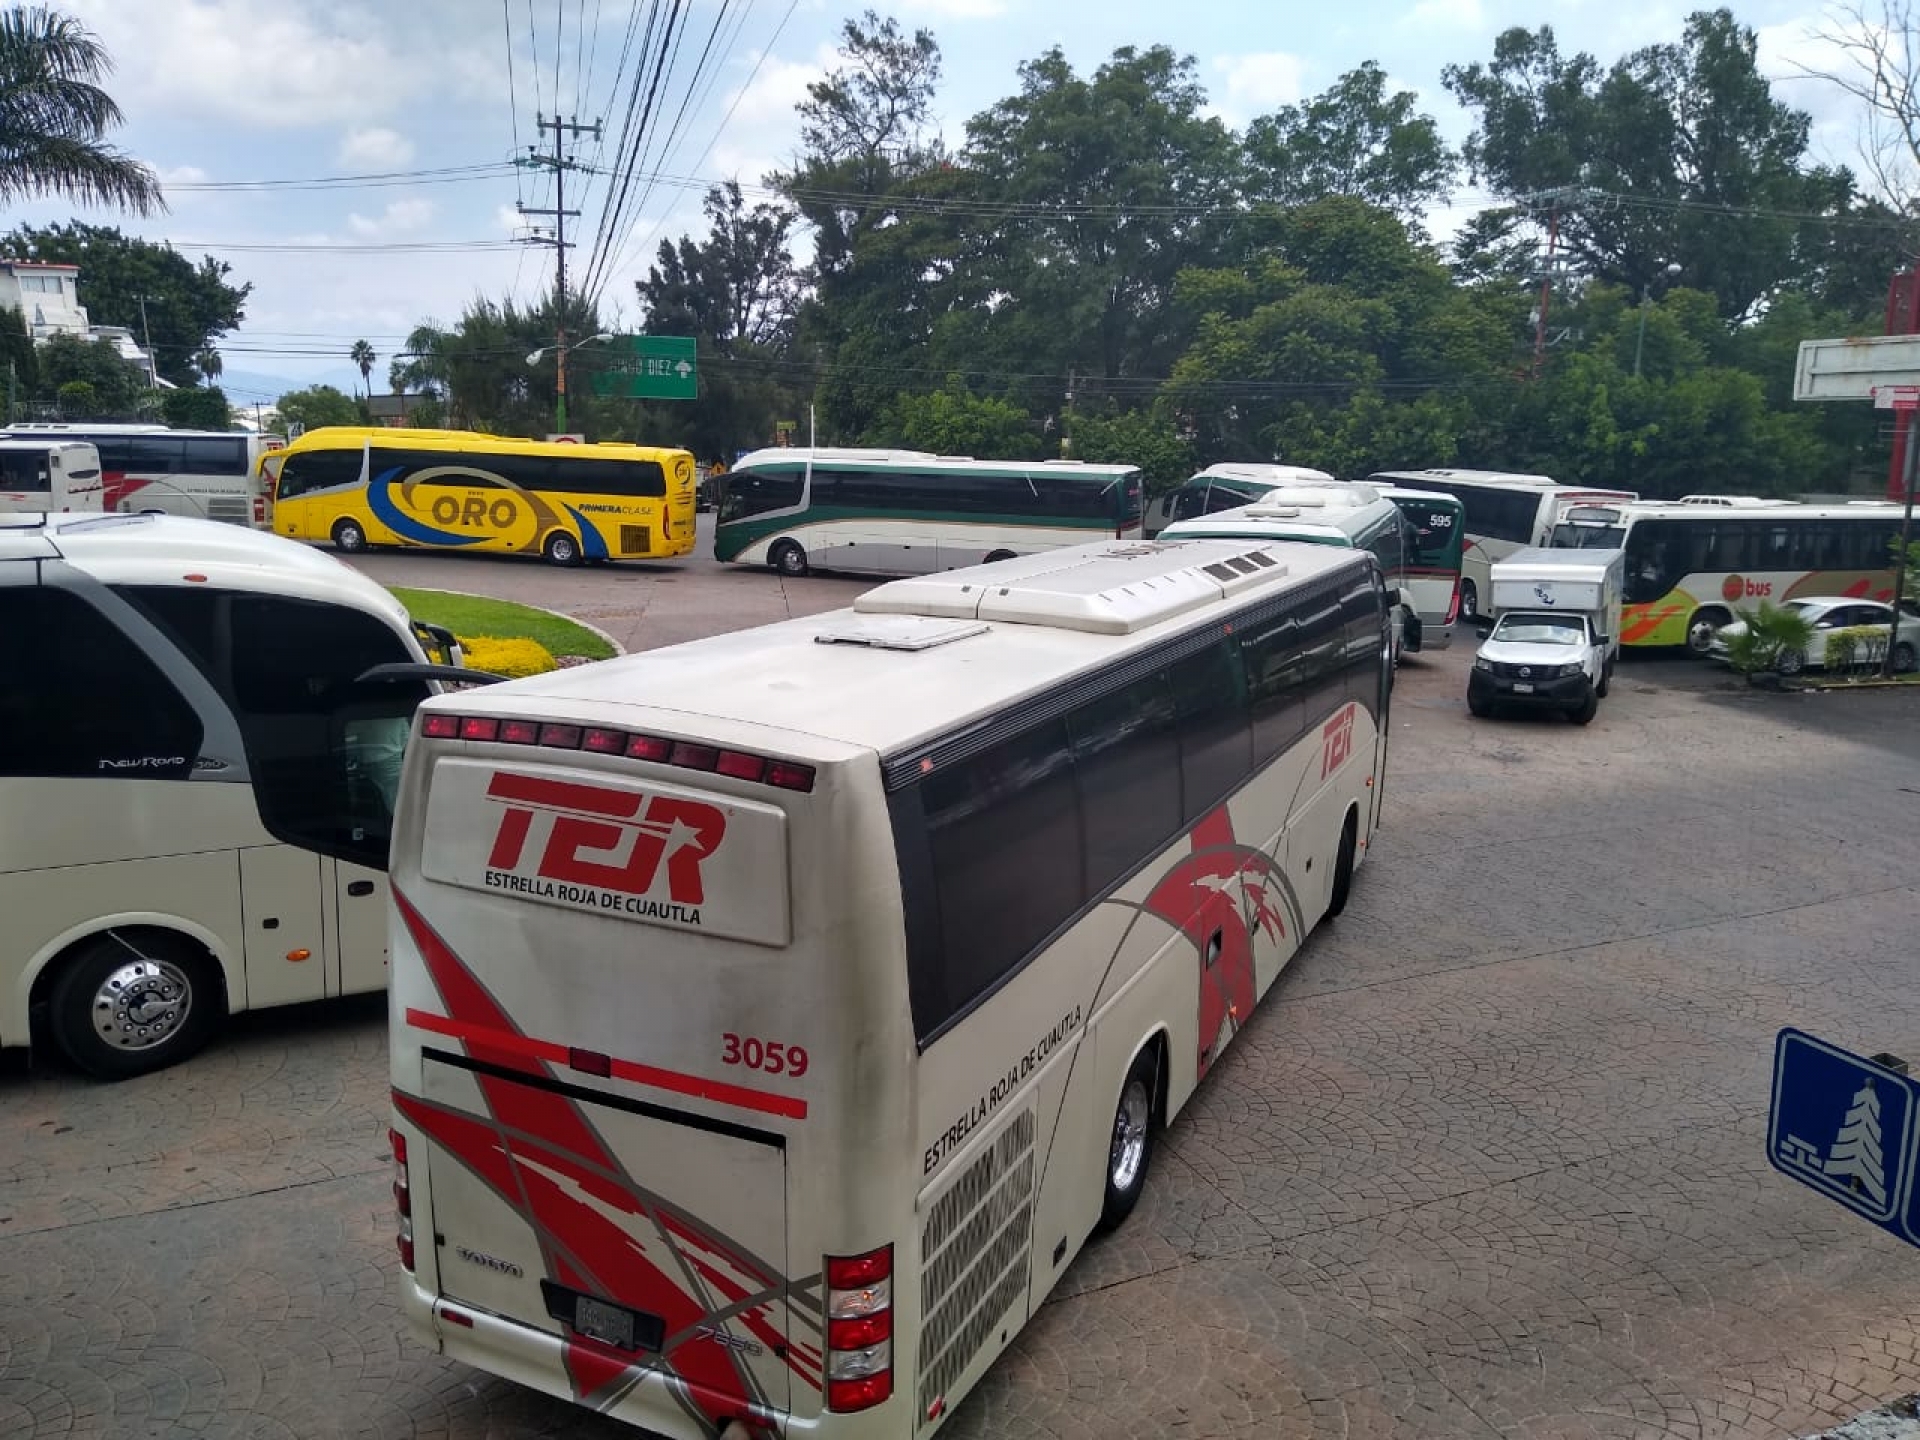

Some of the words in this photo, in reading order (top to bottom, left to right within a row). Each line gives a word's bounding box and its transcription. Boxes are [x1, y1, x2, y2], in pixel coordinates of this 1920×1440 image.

[648, 359, 672, 376] DIEZ
[431, 494, 517, 529] ORO
[1430, 514, 1452, 528] 595
[1745, 577, 1773, 598] bus
[485, 770, 727, 906] TER
[484, 870, 555, 898] ESTRELLA
[557, 885, 597, 906] ROJA
[600, 893, 622, 911] DE
[625, 897, 702, 925] CUAUTLA
[722, 1031, 808, 1078] 3059
[923, 1097, 987, 1177] ESTRELLA
[989, 1065, 1019, 1111] ROJA
[1020, 1047, 1036, 1079] DE
[1037, 1004, 1081, 1062] CUAUTLA
